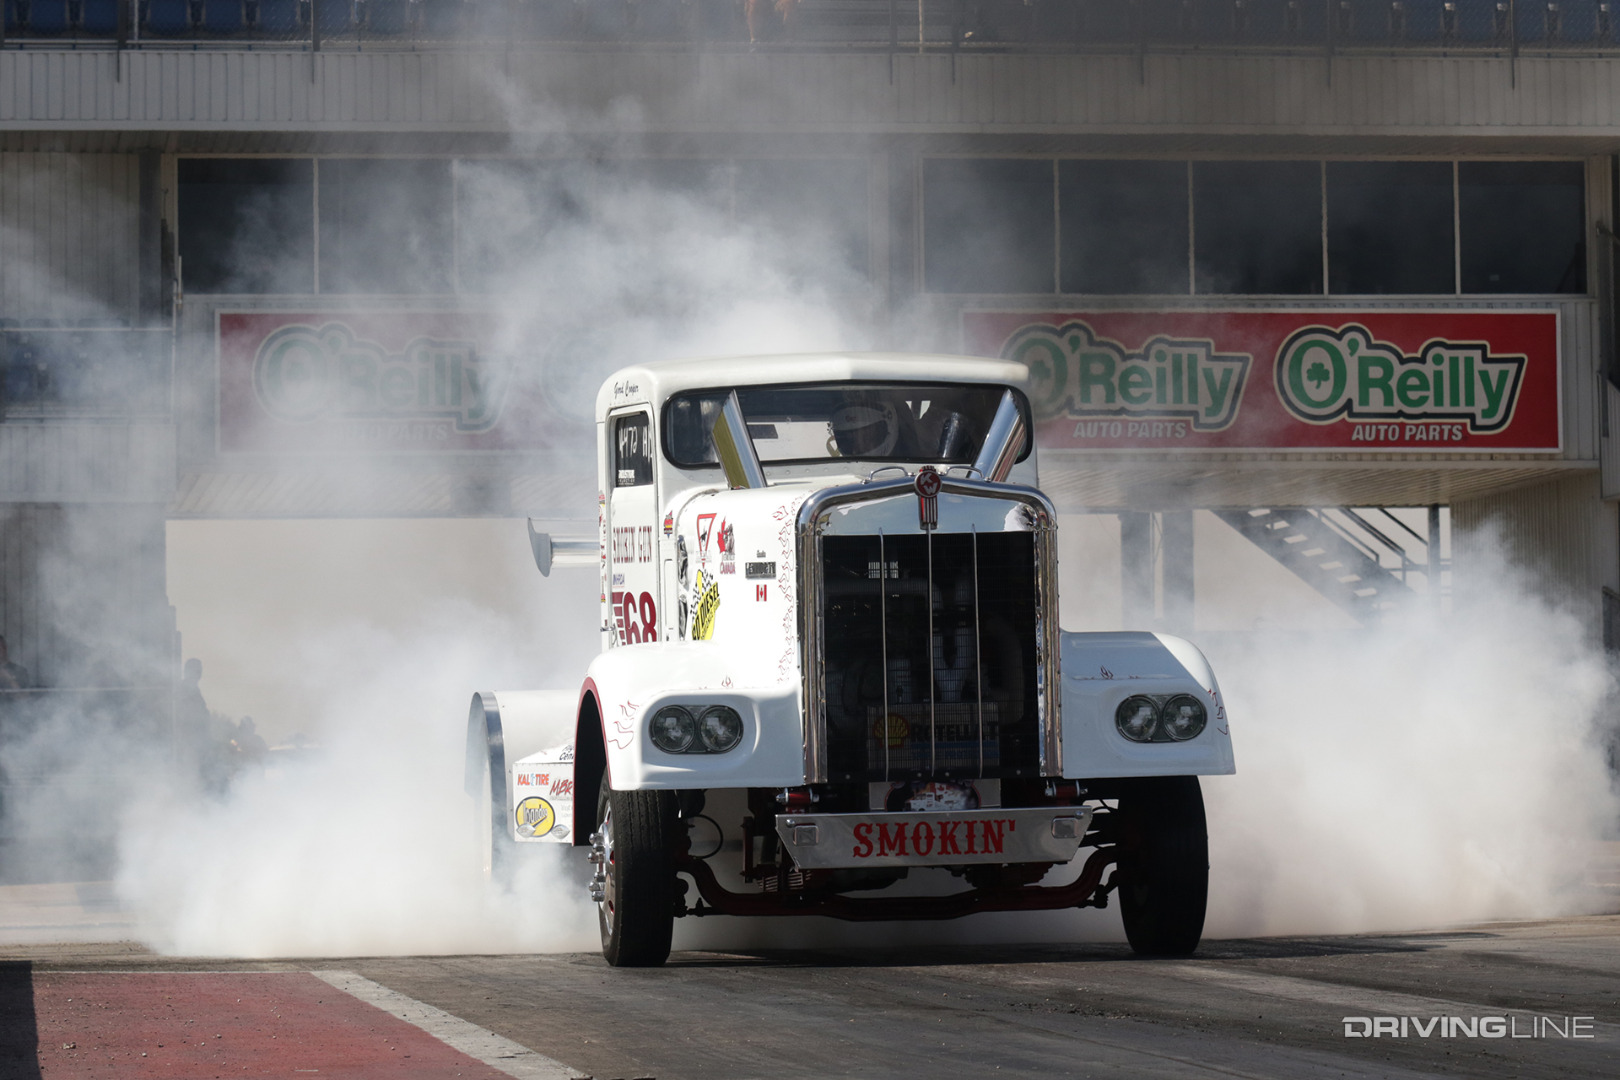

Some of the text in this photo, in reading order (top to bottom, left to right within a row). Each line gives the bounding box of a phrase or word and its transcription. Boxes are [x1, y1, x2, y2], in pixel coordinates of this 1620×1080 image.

[266, 334, 503, 419] O'Reilly
[1011, 336, 1234, 417] O'Reilly
[1288, 338, 1509, 419] O'Reilly
[1073, 421, 1187, 439] AUTO PARTS
[1351, 423, 1463, 442] AUTO PARTS
[920, 472, 938, 495] KW
[517, 773, 550, 786] KAL TIRE
[853, 819, 1016, 858] SMOKIN'
